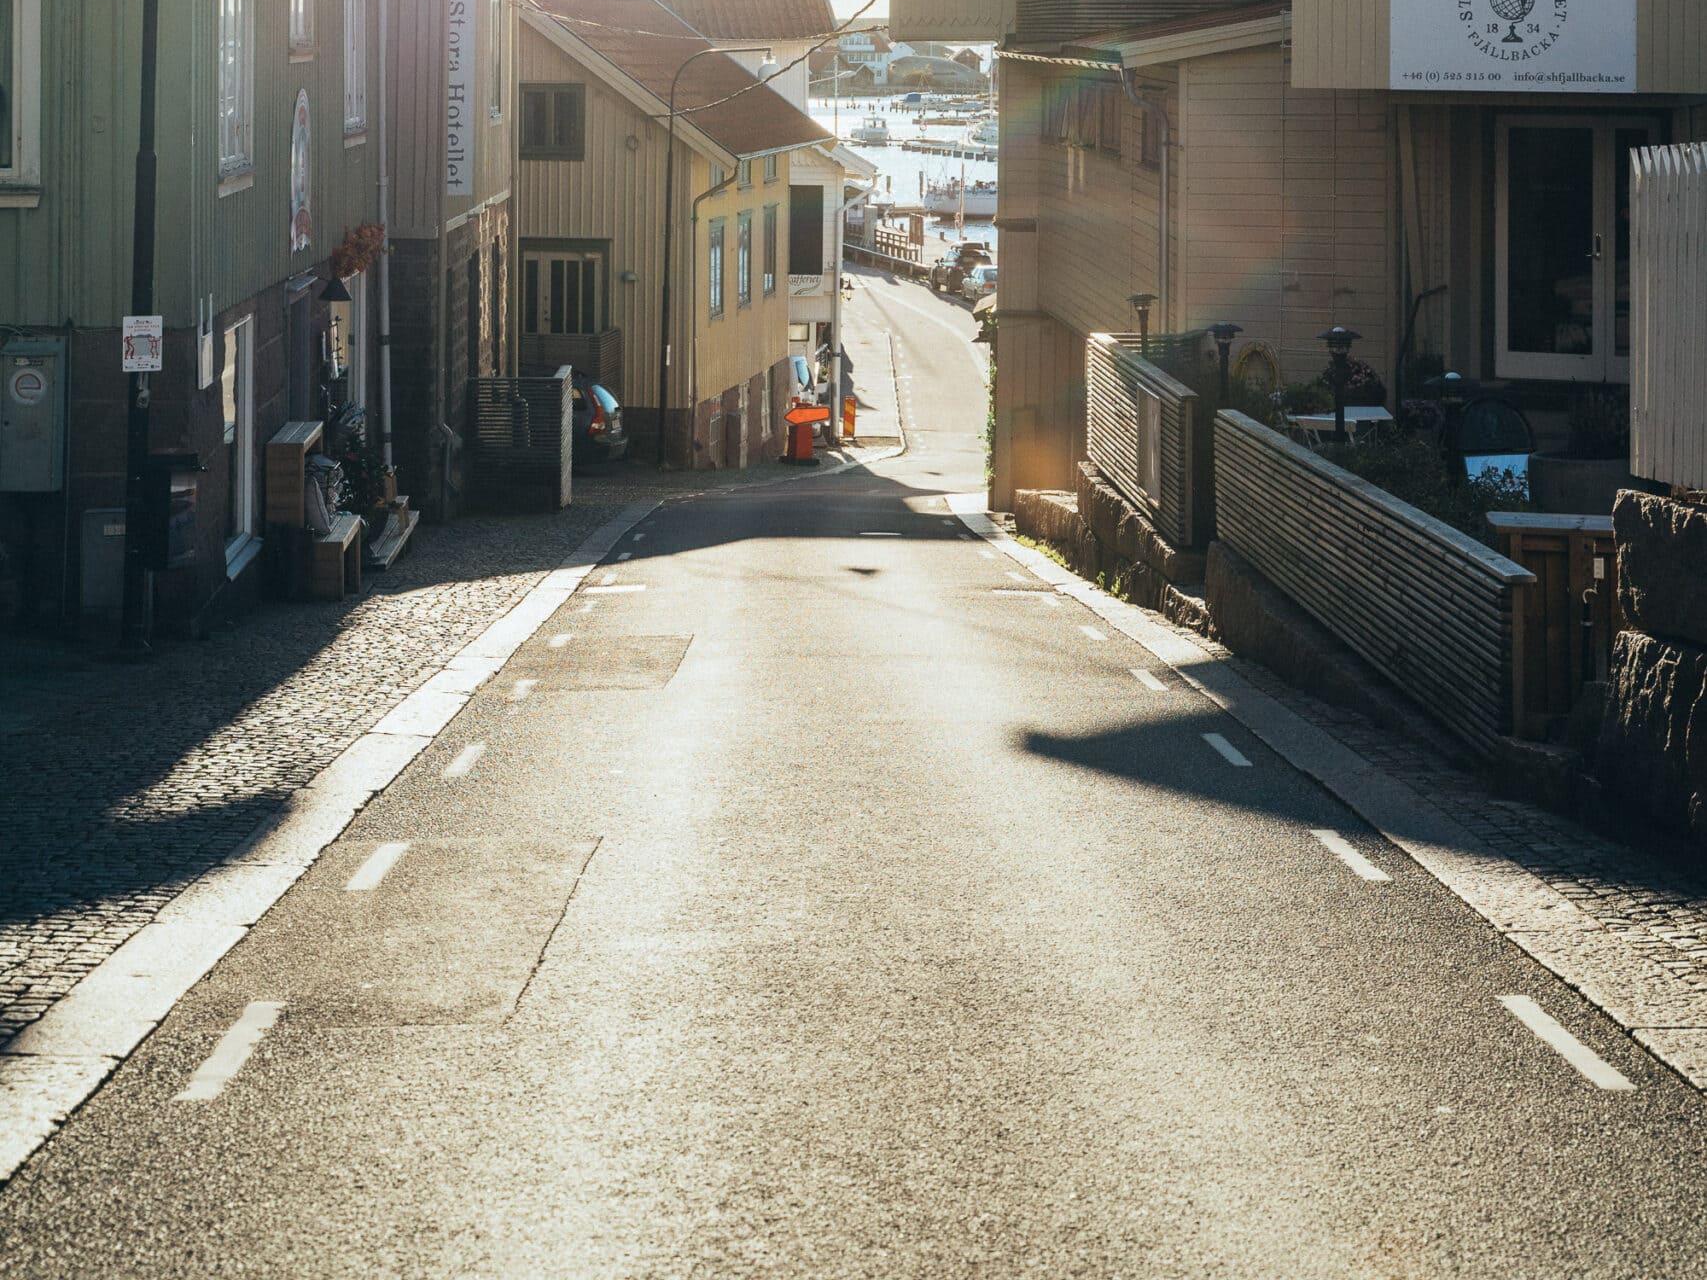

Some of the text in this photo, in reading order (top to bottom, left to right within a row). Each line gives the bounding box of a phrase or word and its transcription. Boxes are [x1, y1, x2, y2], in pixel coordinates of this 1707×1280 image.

[1486, 23, 1540, 34] 18 34
[1467, 31, 1560, 61] FJÄLLBACKA
[1402, 71, 1625, 85] +46 (0) 525 315 00 info@shfjallbacka.se
[447, 0, 466, 188] Stora Hotellet
